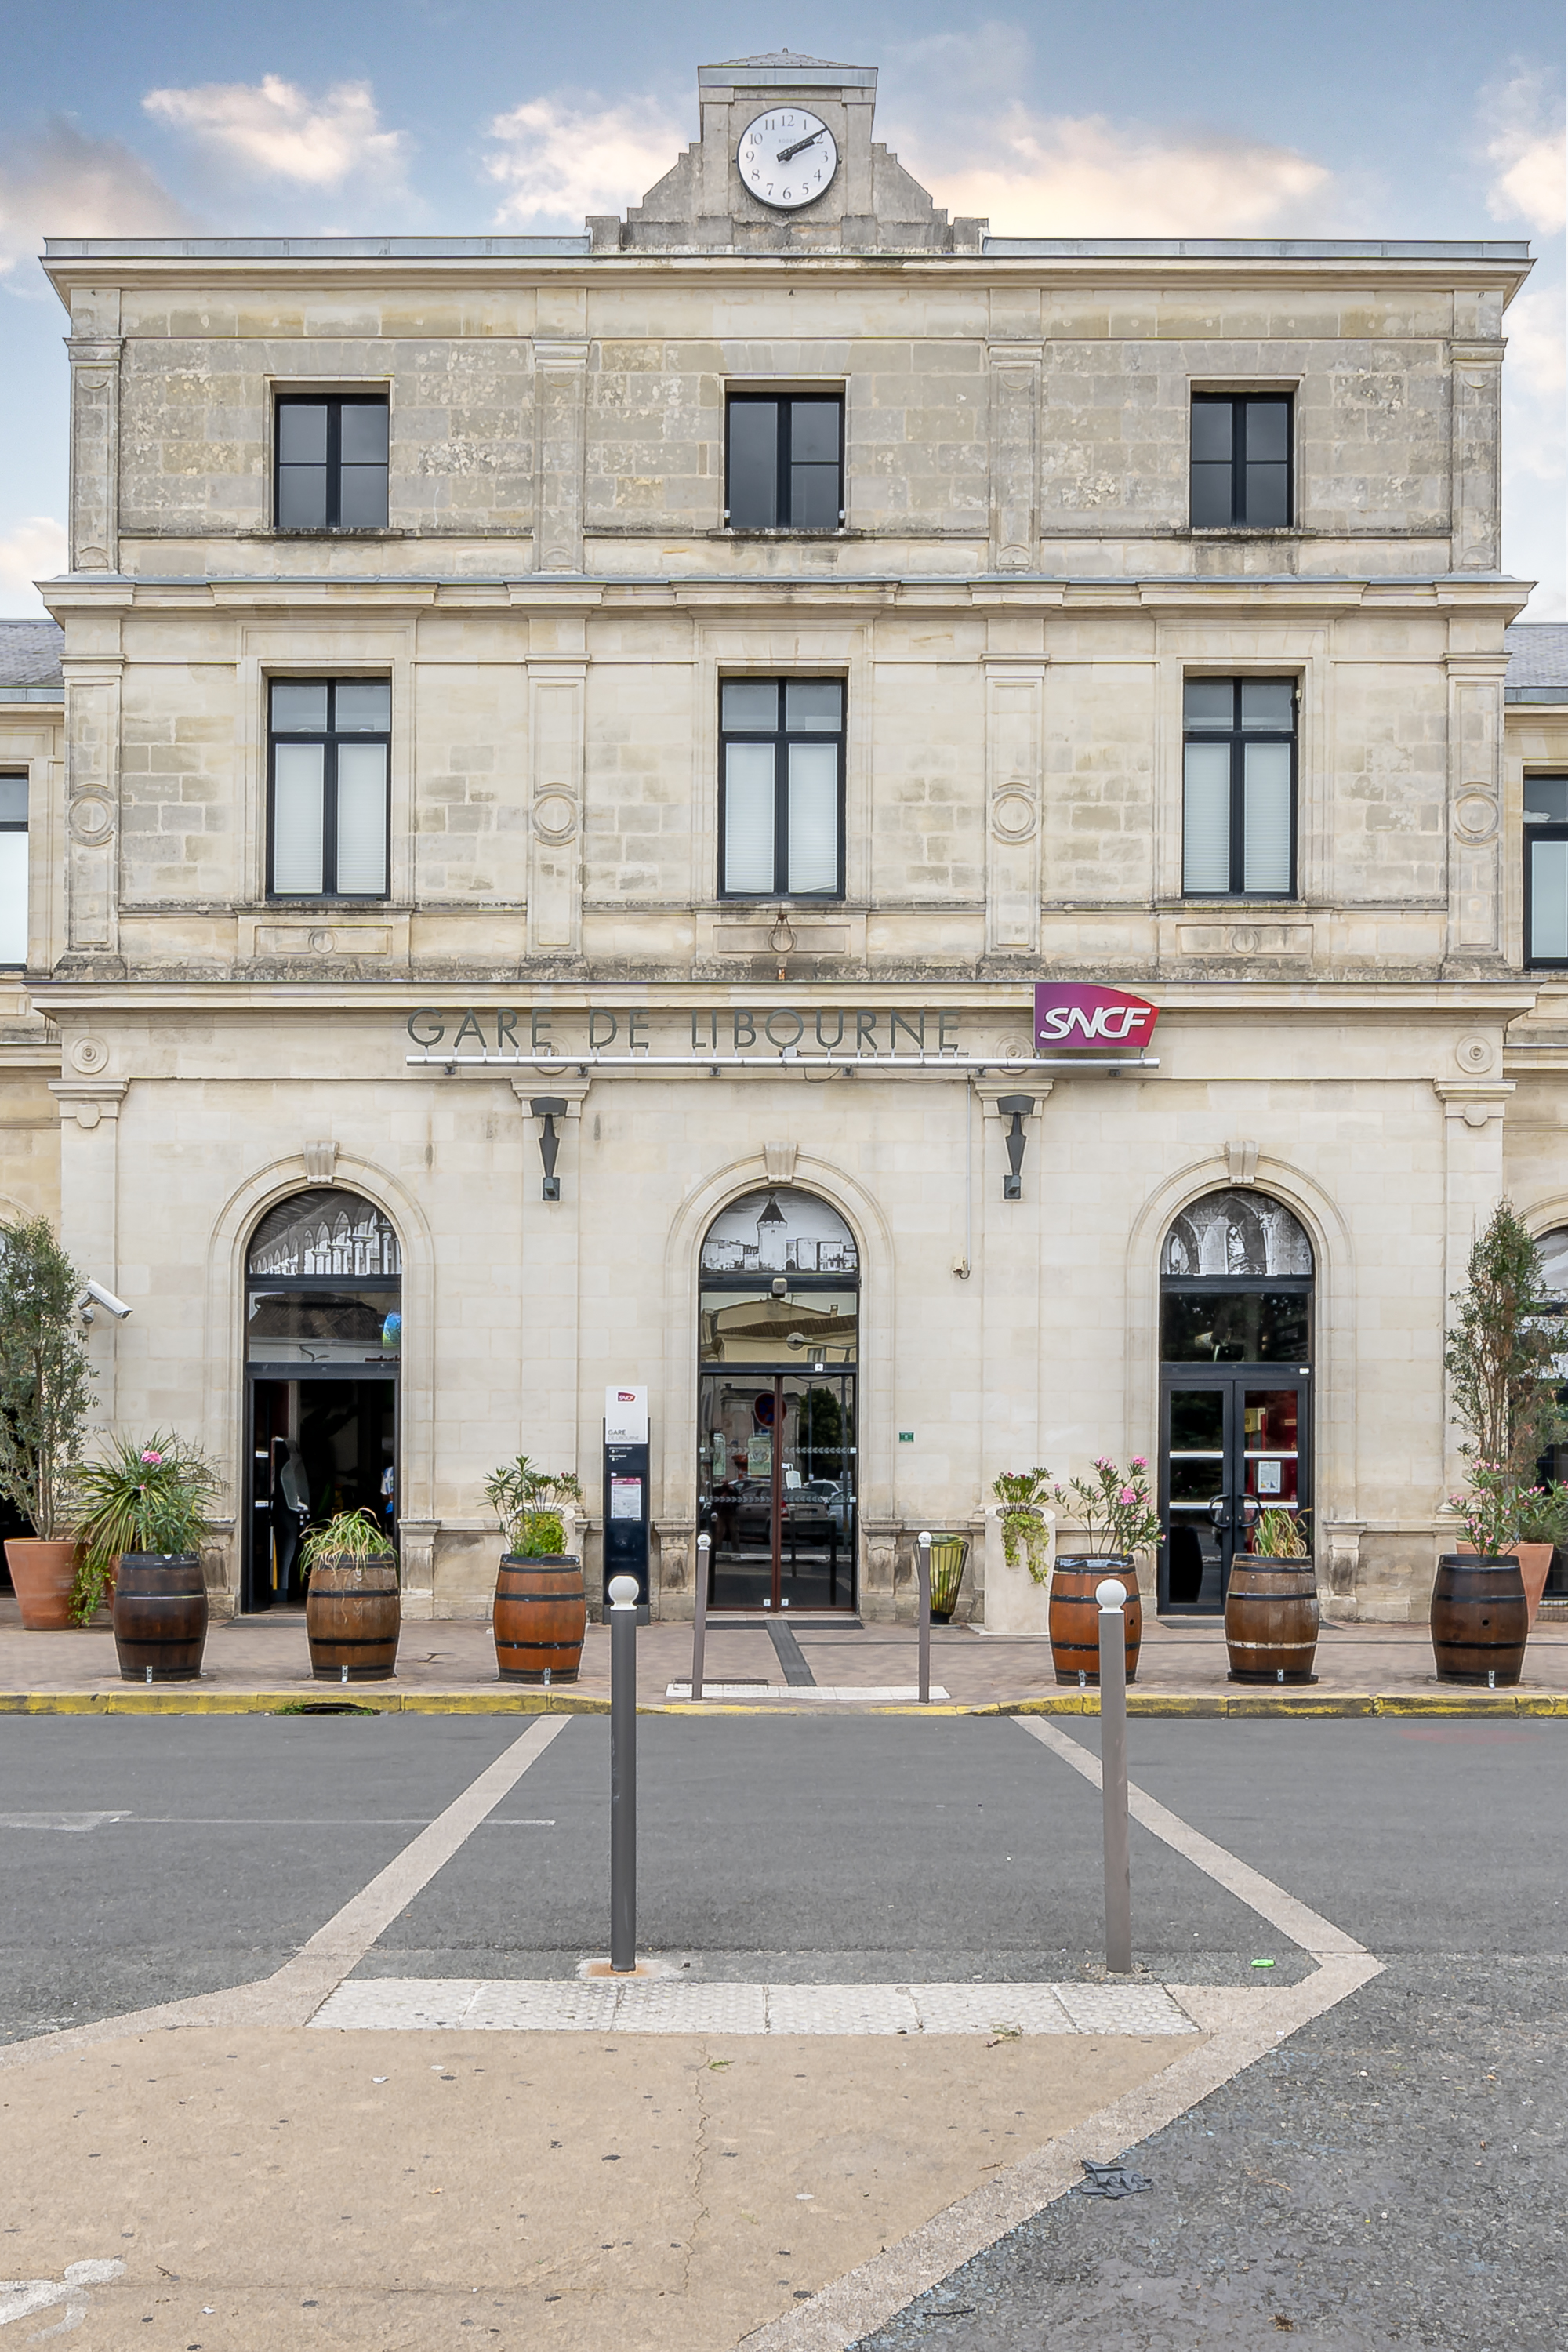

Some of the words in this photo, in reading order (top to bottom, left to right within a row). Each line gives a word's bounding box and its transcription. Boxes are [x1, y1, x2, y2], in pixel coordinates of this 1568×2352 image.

[764, 119, 775, 131] 11
[782, 114, 795, 127] 12
[804, 118, 808, 131] 1
[750, 132, 763, 145] 10
[816, 132, 824, 144] 2
[746, 151, 755, 163] 9
[821, 151, 829, 163] 3
[751, 169, 760, 181] 8
[813, 169, 822, 182] 4
[766, 183, 774, 196] 7
[782, 187, 792, 200] 6
[802, 182, 810, 195] 5
[407, 1007, 552, 1047] GARE
[590, 1008, 649, 1047] DE
[691, 1008, 960, 1049] LIBOURNE
[1039, 1007, 1152, 1040] SNCF
